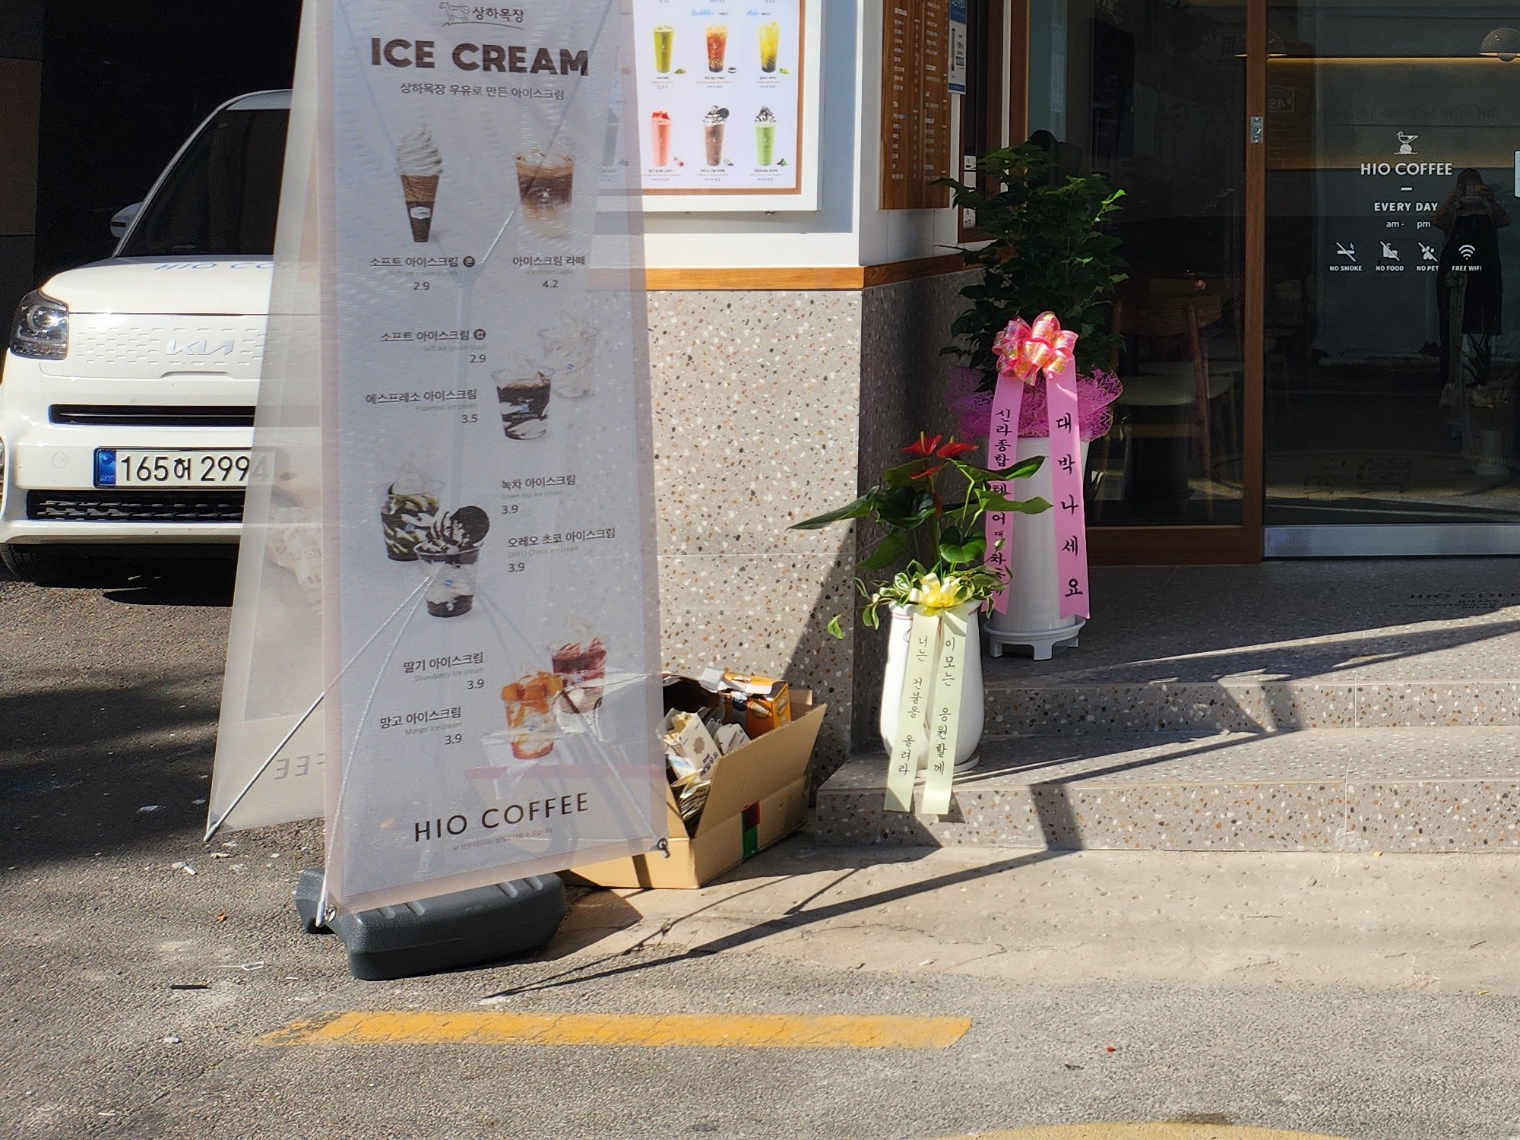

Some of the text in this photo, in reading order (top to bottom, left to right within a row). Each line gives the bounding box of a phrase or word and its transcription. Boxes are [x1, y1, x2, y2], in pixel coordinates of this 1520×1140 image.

[472, 6, 525, 23] 상하목장
[371, 37, 589, 77] ICE CREAM
[400, 82, 565, 100] 상하목장 우유로 만든 아이스크림
[1360, 162, 1453, 176] HIO COFFEE
[1373, 202, 1439, 212] EVERY DAY
[1416, 220, 1431, 230] pm
[370, 256, 402, 268] 소프트
[405, 255, 459, 268] 아이스크림
[512, 255, 586, 267] 아이스크림 라떼
[413, 281, 430, 291] 2.9
[542, 279, 559, 289] 4.2
[381, 331, 414, 343] 소프트
[416, 329, 470, 342] 아이스크림
[469, 354, 486, 364] 2.9
[365, 388, 477, 405] 에스프레소 아이스크림
[461, 414, 478, 424] 3.5
[121, 455, 191, 482] 165허
[501, 474, 577, 491] 녹차 아이스크림
[501, 504, 519, 515] 3.9
[508, 527, 616, 548] 오레오 초코 아이스크림
[508, 562, 525, 573] 3.9
[403, 651, 484, 674] 딸기 아이스크림
[467, 678, 485, 690] 3.9
[380, 706, 462, 730] 망고 아이스크림
[444, 733, 462, 746] 3.9
[415, 814, 467, 843] HIO
[481, 791, 590, 829] COFFEE
